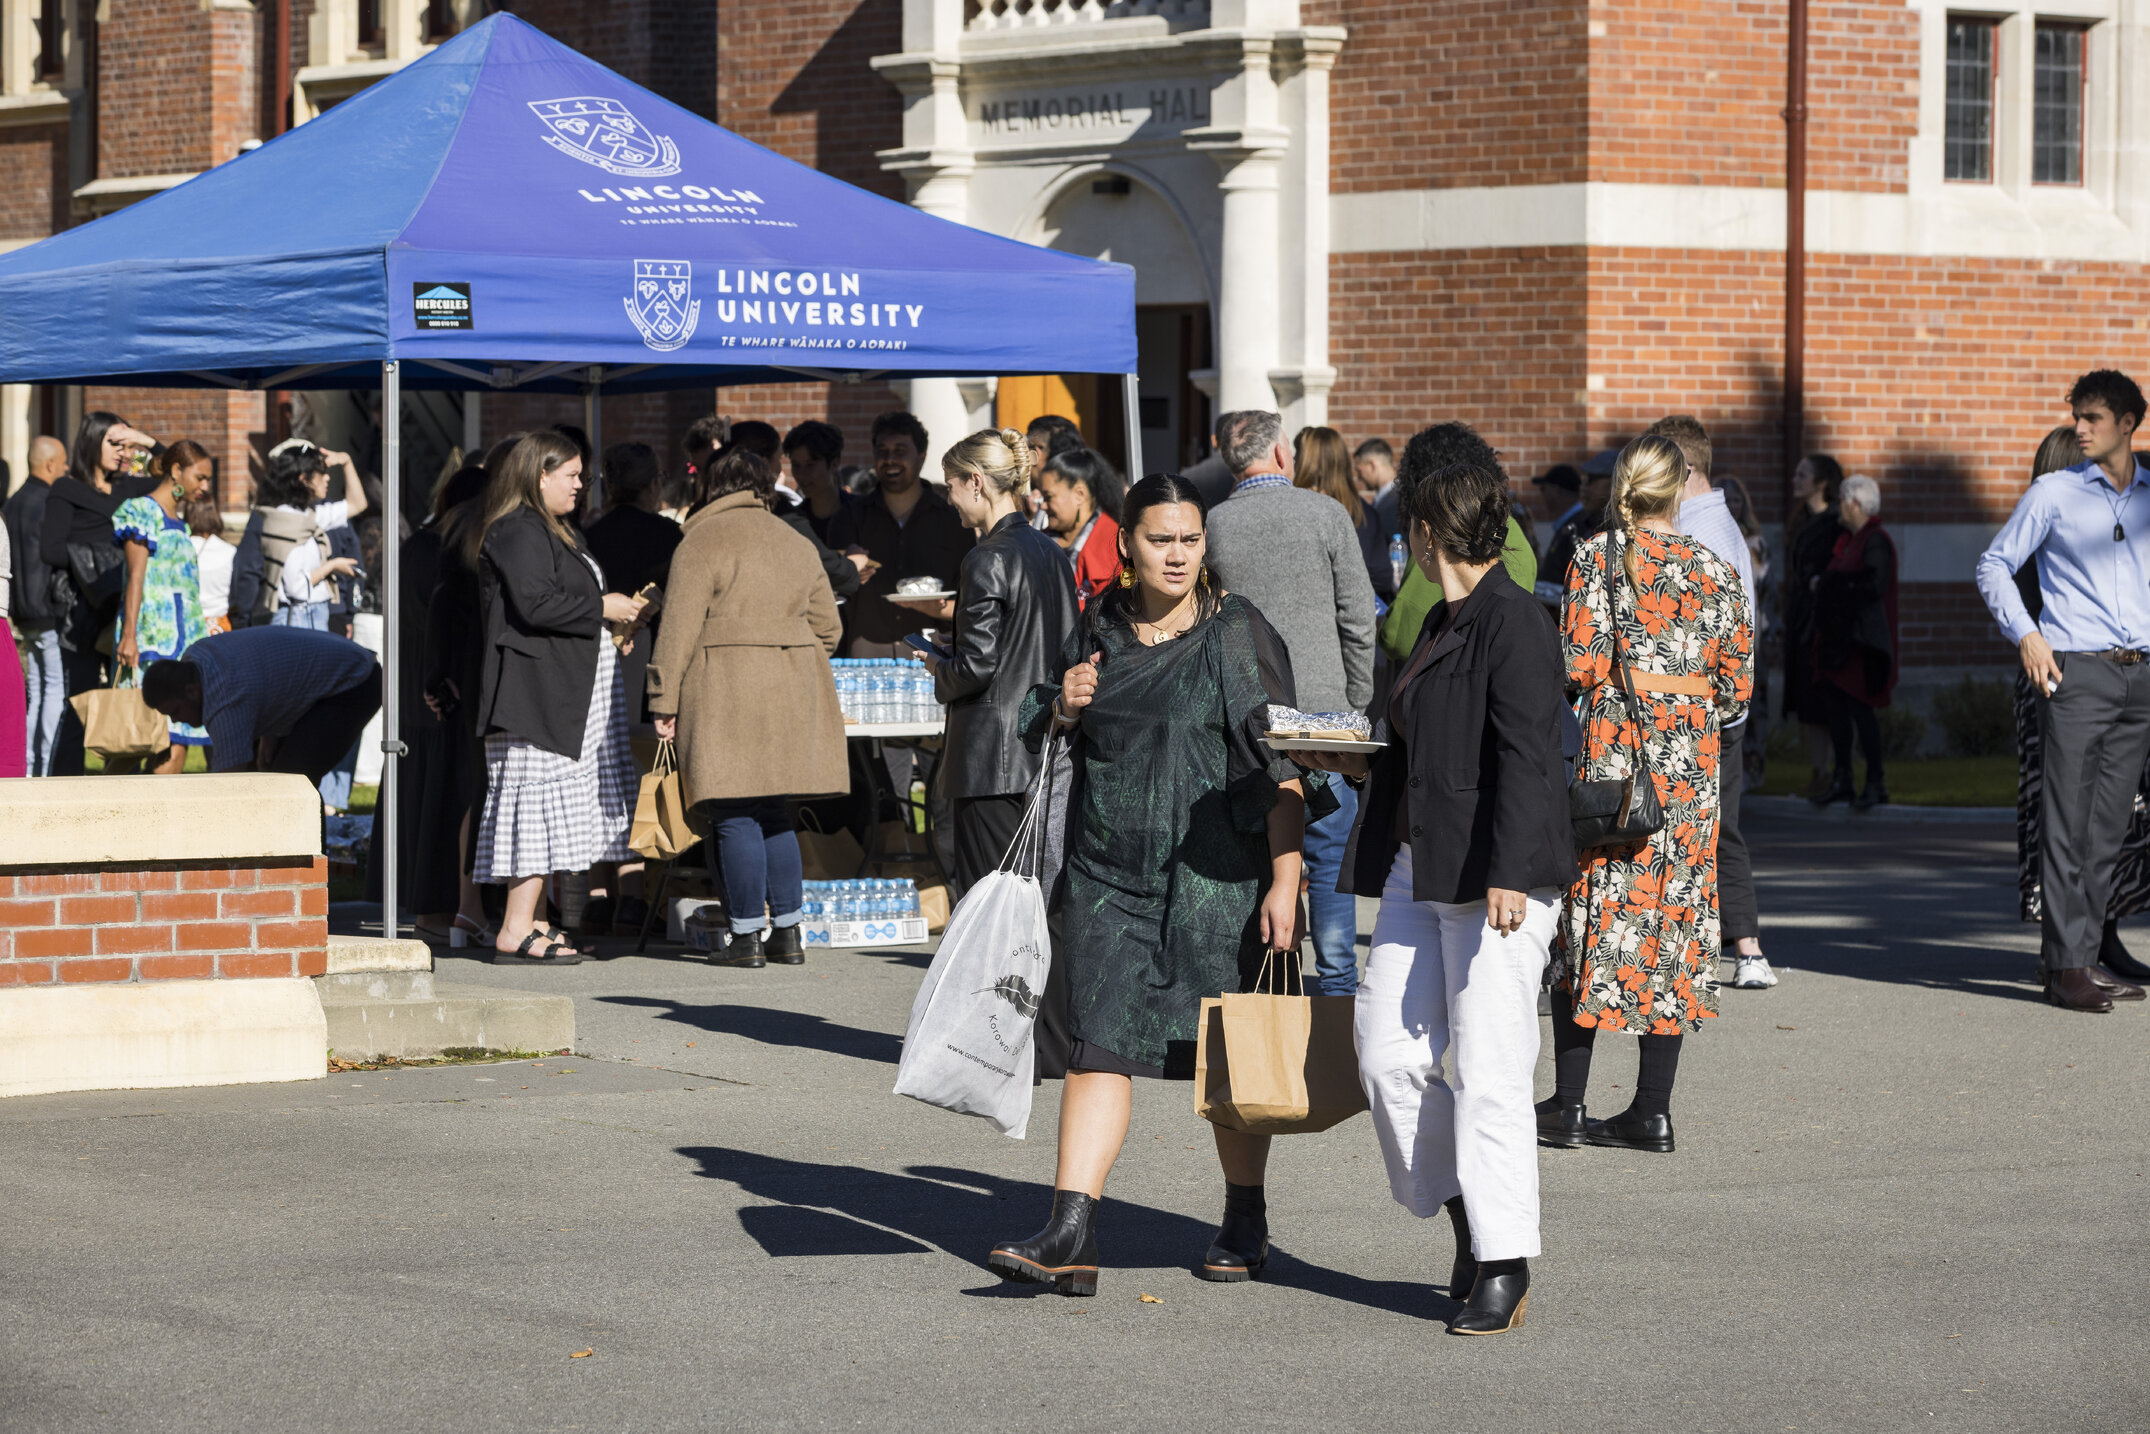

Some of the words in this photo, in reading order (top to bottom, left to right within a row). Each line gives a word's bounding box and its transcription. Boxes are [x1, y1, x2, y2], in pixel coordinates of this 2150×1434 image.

[981, 91, 1133, 135] MEMORIAL
[1149, 86, 1212, 123] HAL
[578, 185, 765, 204] LINCOLN
[626, 204, 758, 215] UNIVERSITY
[718, 269, 860, 296] LINCOLN
[415, 299, 469, 310] HERCULES
[718, 299, 924, 328] UNIVERSITY
[721, 336, 736, 347] TE
[741, 337, 785, 347] WHARE
[789, 336, 842, 349] WĀNAKA
[846, 339, 856, 349] O
[859, 339, 907, 350] AORAKI
[989, 1014, 1012, 1054] Korowai
